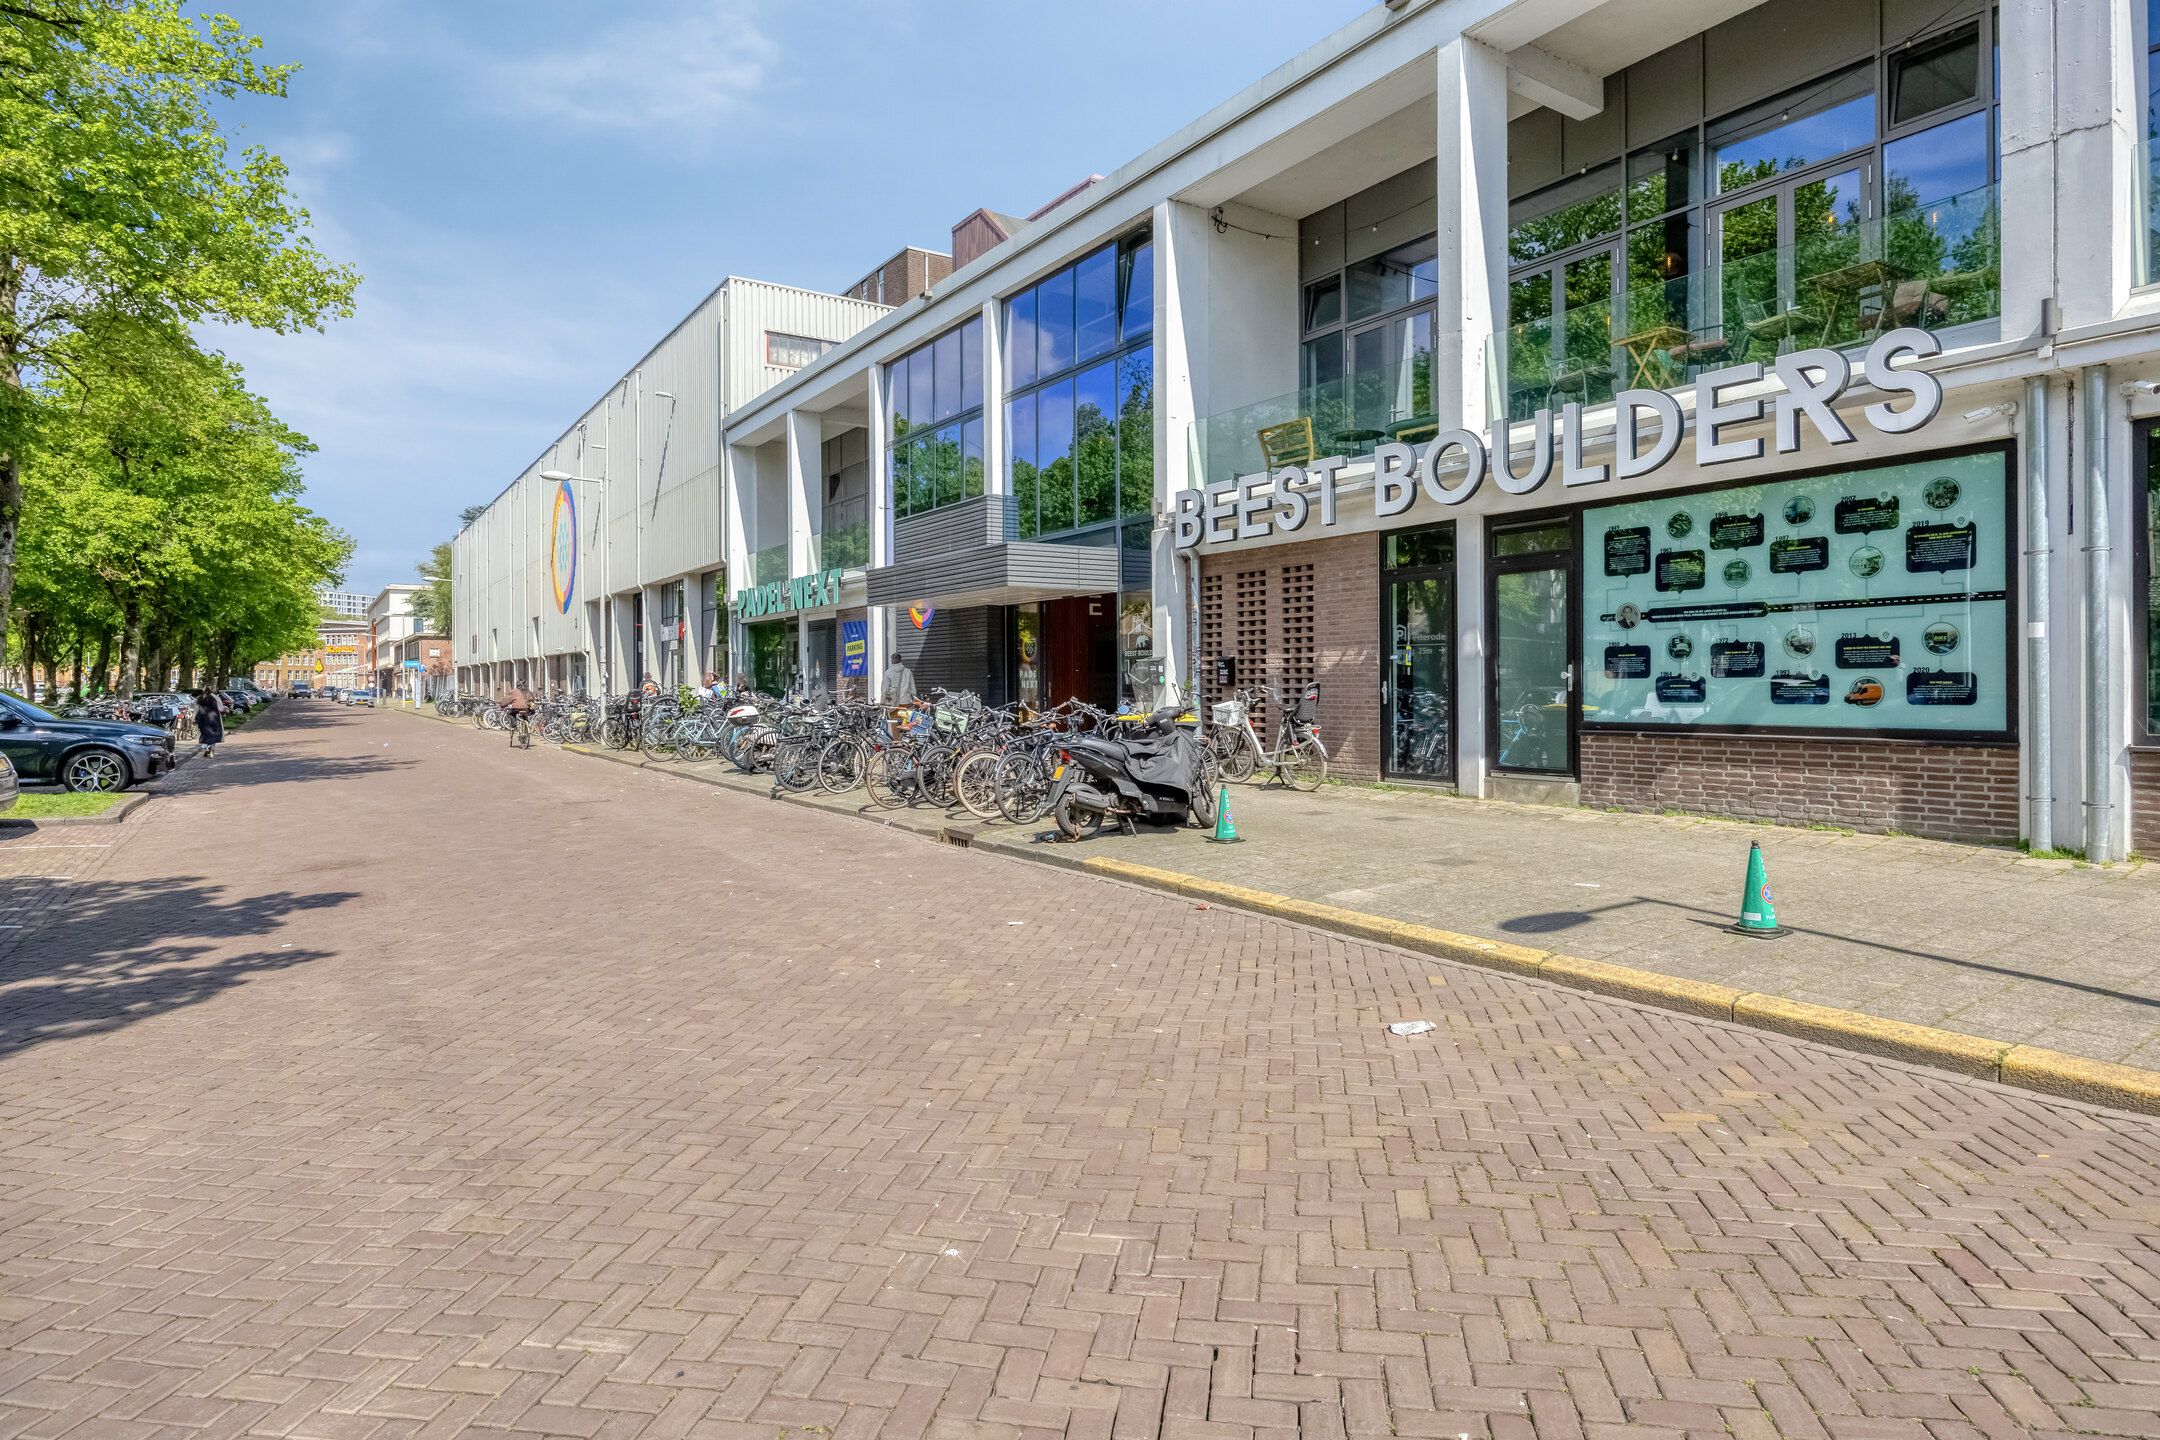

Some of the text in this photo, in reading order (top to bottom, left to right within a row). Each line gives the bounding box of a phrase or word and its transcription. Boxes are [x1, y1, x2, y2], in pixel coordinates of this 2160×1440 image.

[1175, 327, 1942, 549] BEEST BOULDERS
[1912, 520, 1929, 528] 2019
[737, 567, 844, 619] PADEL NEXT
[846, 642, 863, 653] PARKING
[1021, 680, 1038, 689] NEXT
